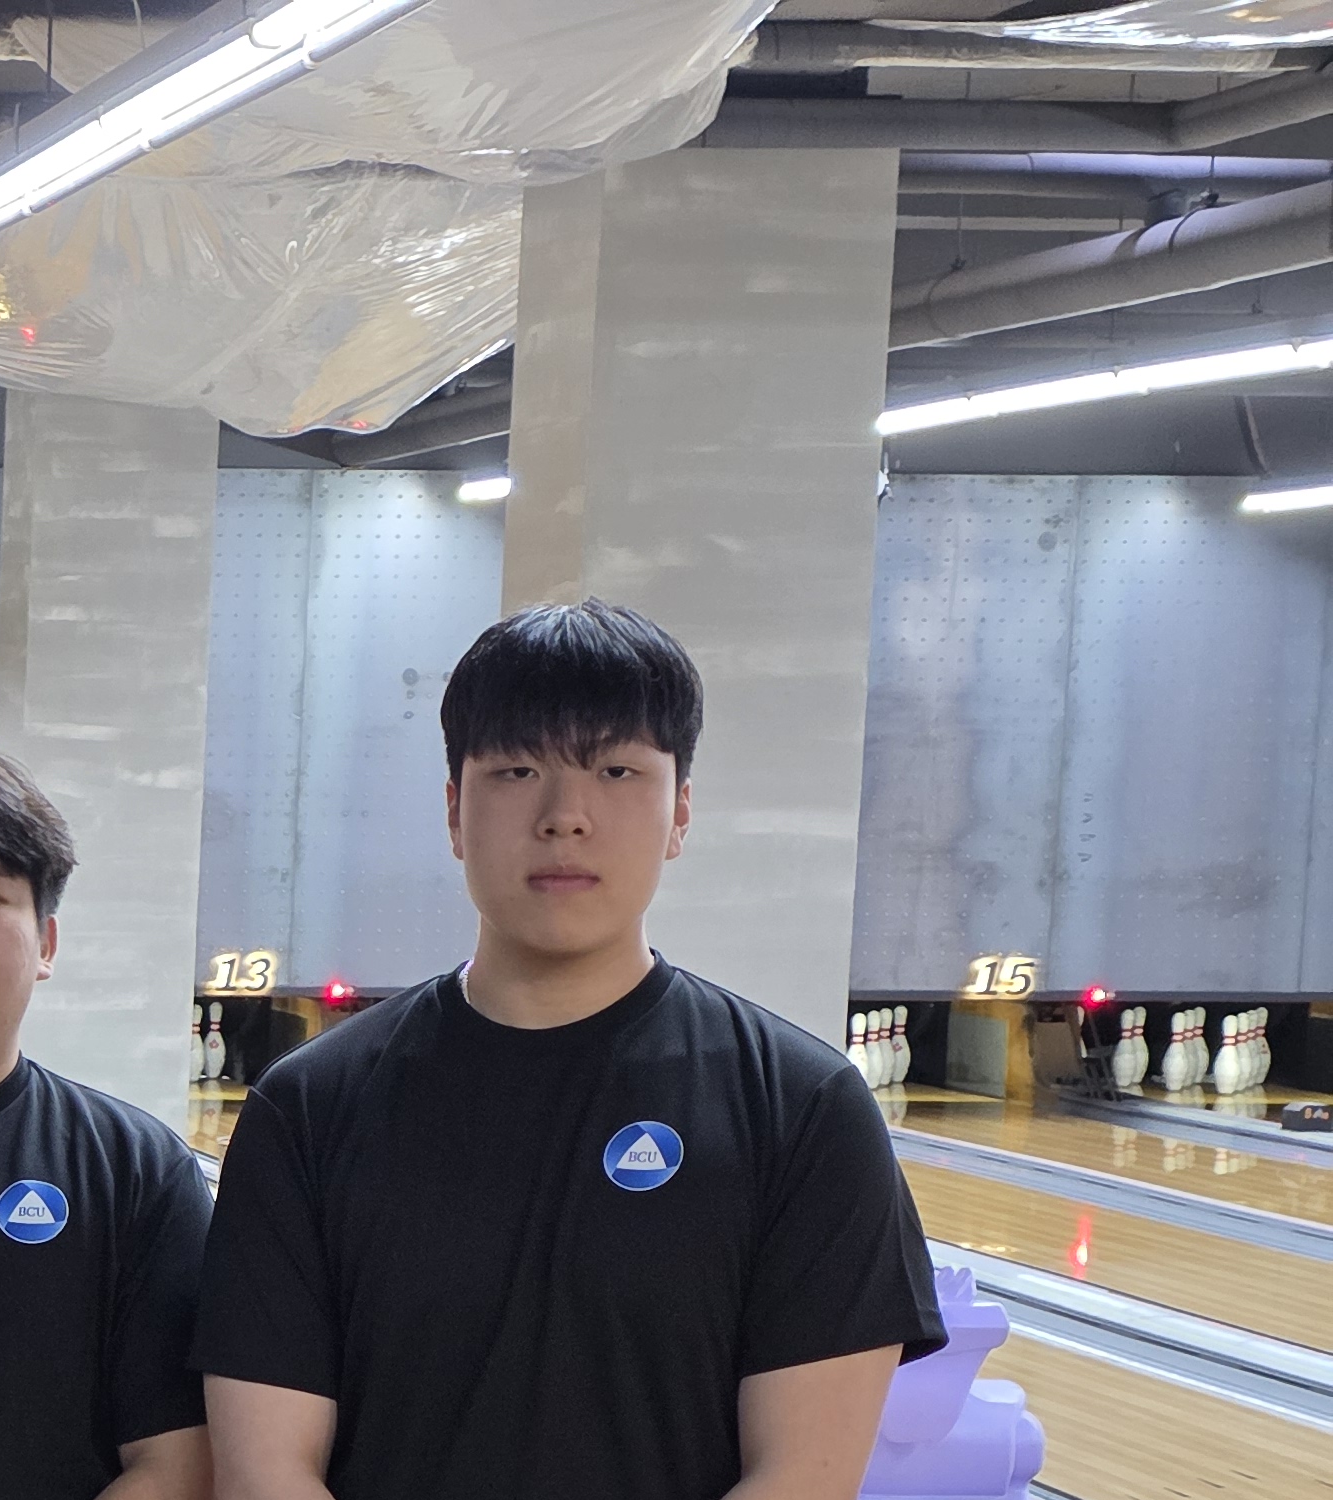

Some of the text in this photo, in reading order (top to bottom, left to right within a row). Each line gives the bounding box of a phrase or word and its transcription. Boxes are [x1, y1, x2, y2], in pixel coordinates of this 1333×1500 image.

[210, 955, 274, 993] 13
[971, 959, 1035, 997] 15
[628, 1151, 658, 1163] BCU
[18, 1206, 46, 1217] BCU
